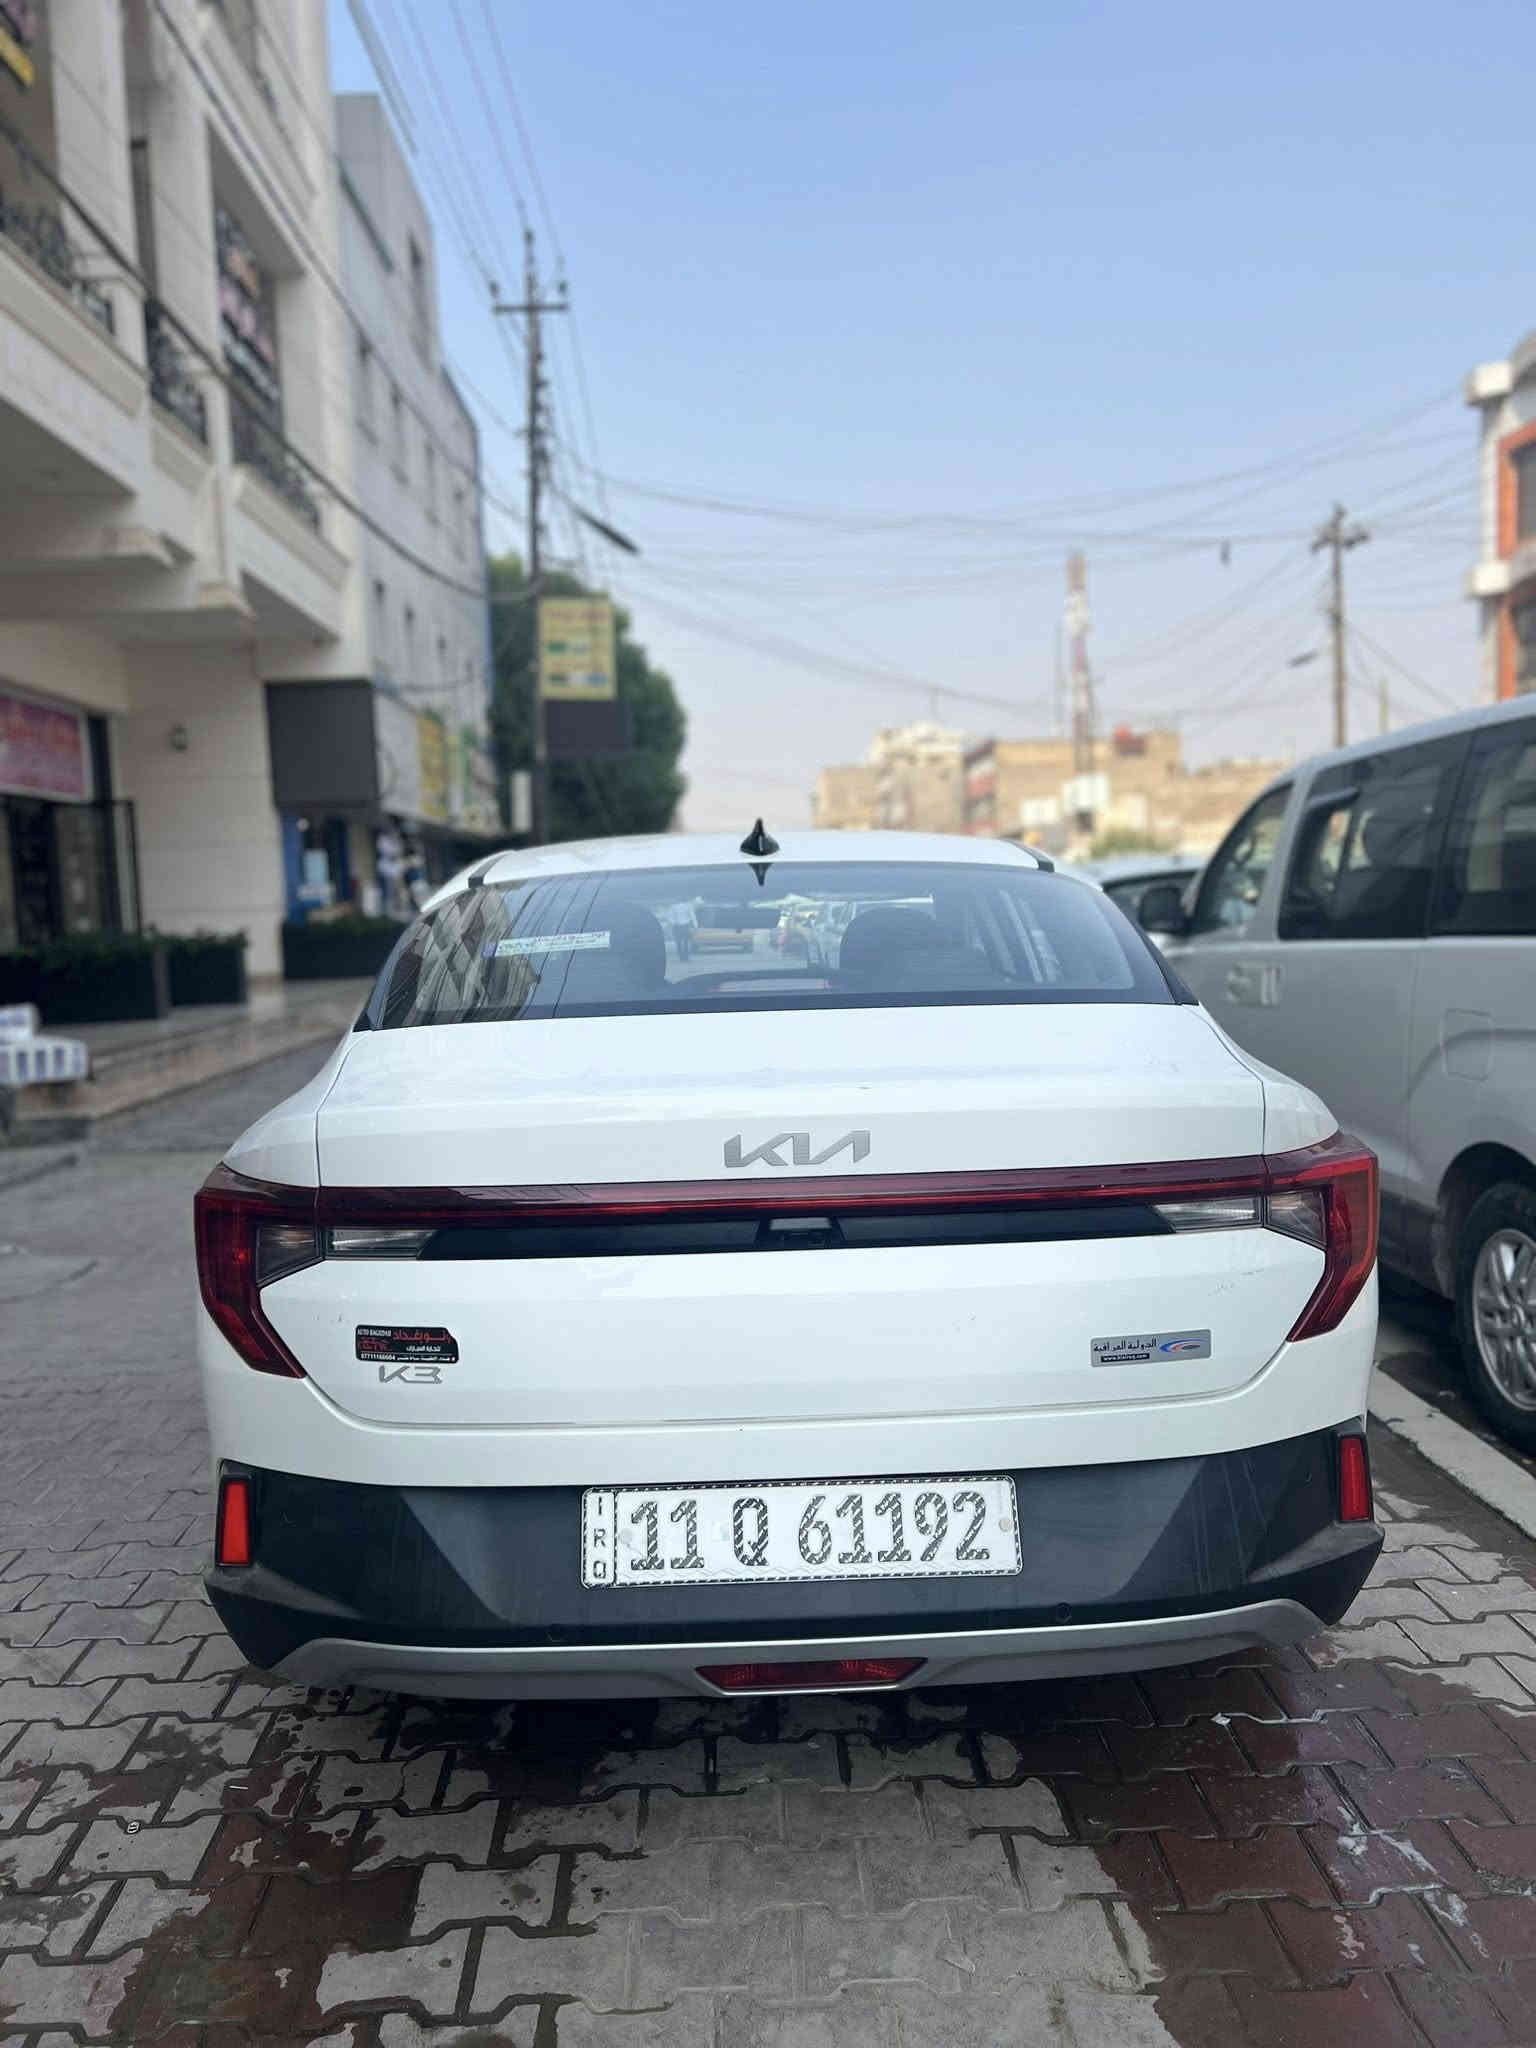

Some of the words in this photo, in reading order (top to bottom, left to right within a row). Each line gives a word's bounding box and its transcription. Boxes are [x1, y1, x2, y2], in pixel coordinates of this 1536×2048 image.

[724, 1130, 871, 1168] KIA
[378, 1365, 442, 1384] K3
[630, 1498, 705, 1571] 11
[732, 1496, 769, 1567] Q
[798, 1491, 990, 1565] 61192
